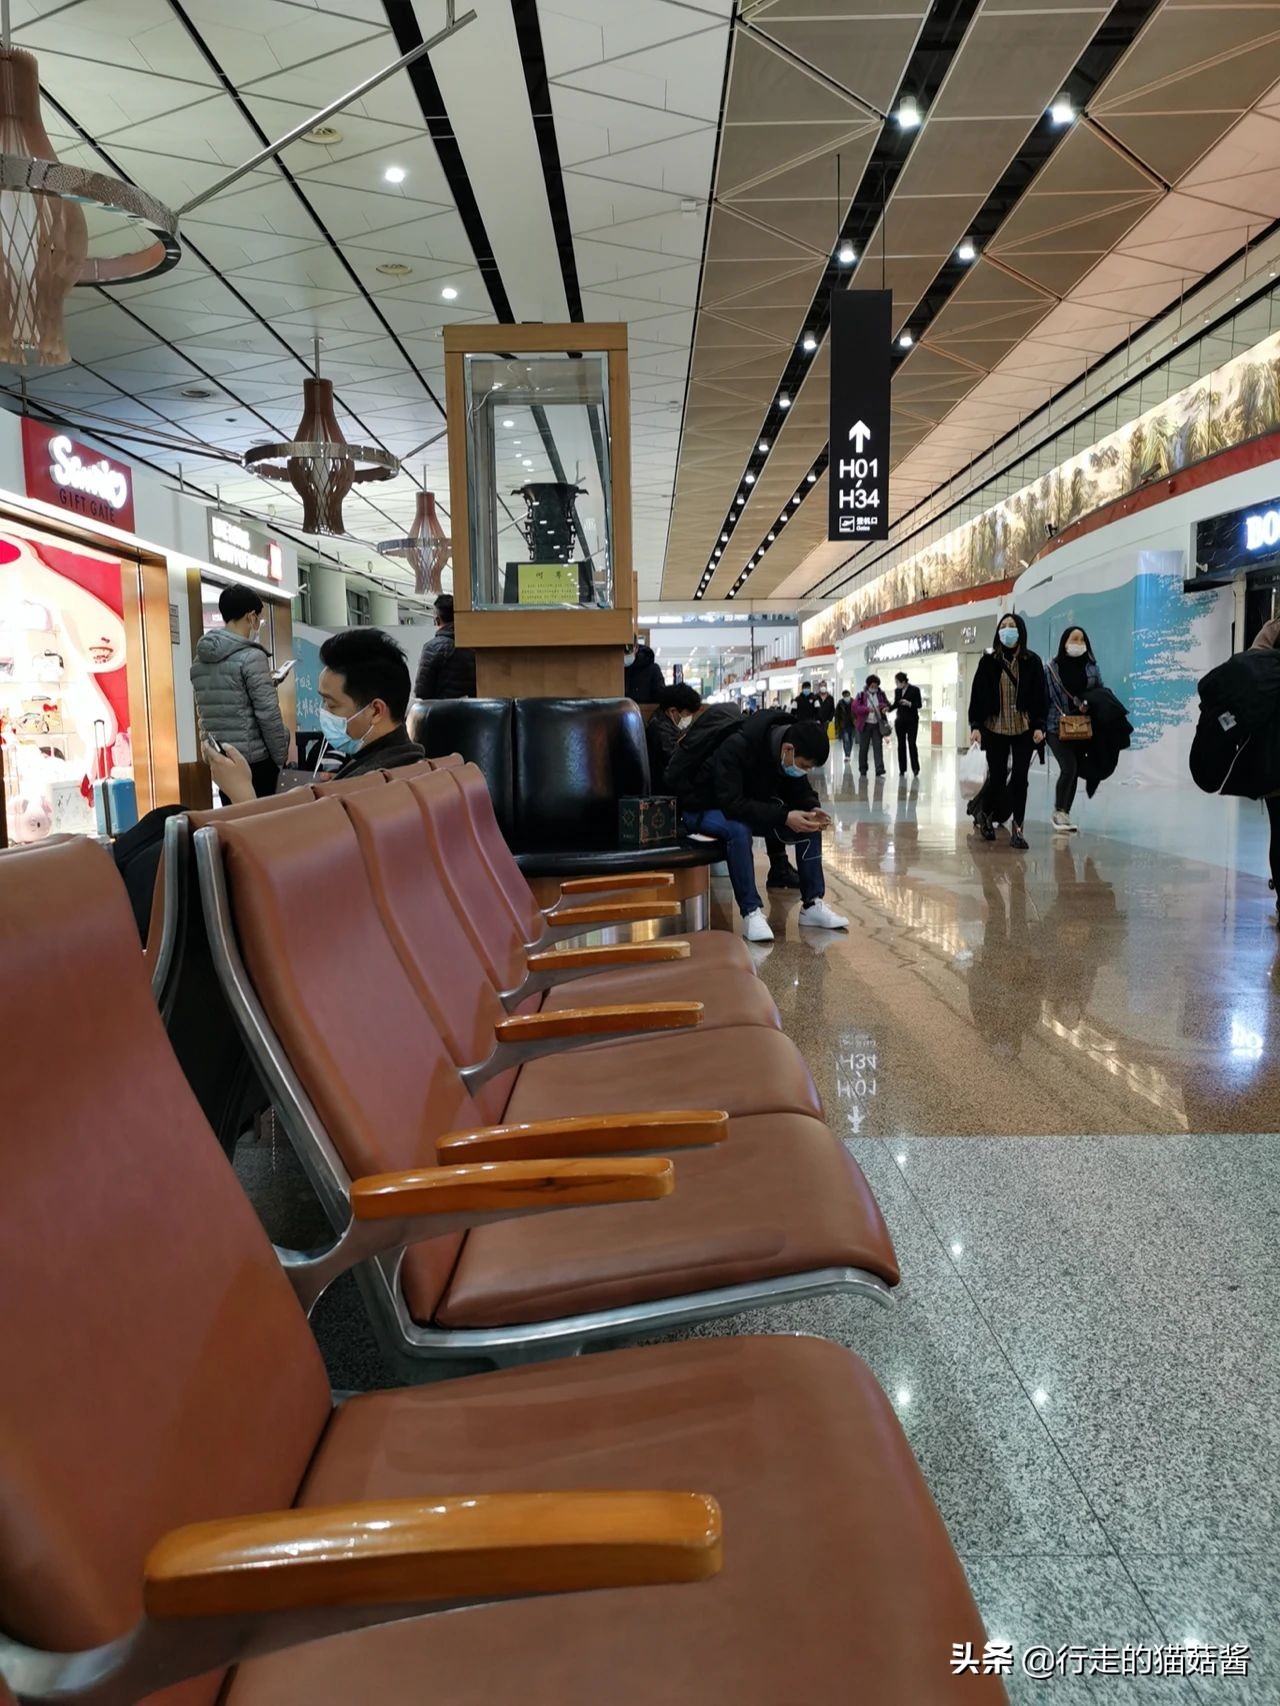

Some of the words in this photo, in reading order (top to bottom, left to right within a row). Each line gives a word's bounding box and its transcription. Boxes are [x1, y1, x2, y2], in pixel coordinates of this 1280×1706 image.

[839, 458, 878, 479] H01
[59, 488, 86, 512] GIFT
[90, 501, 115, 523] GATE
[838, 488, 881, 509] H34
[1246, 509, 1280, 551] BO
